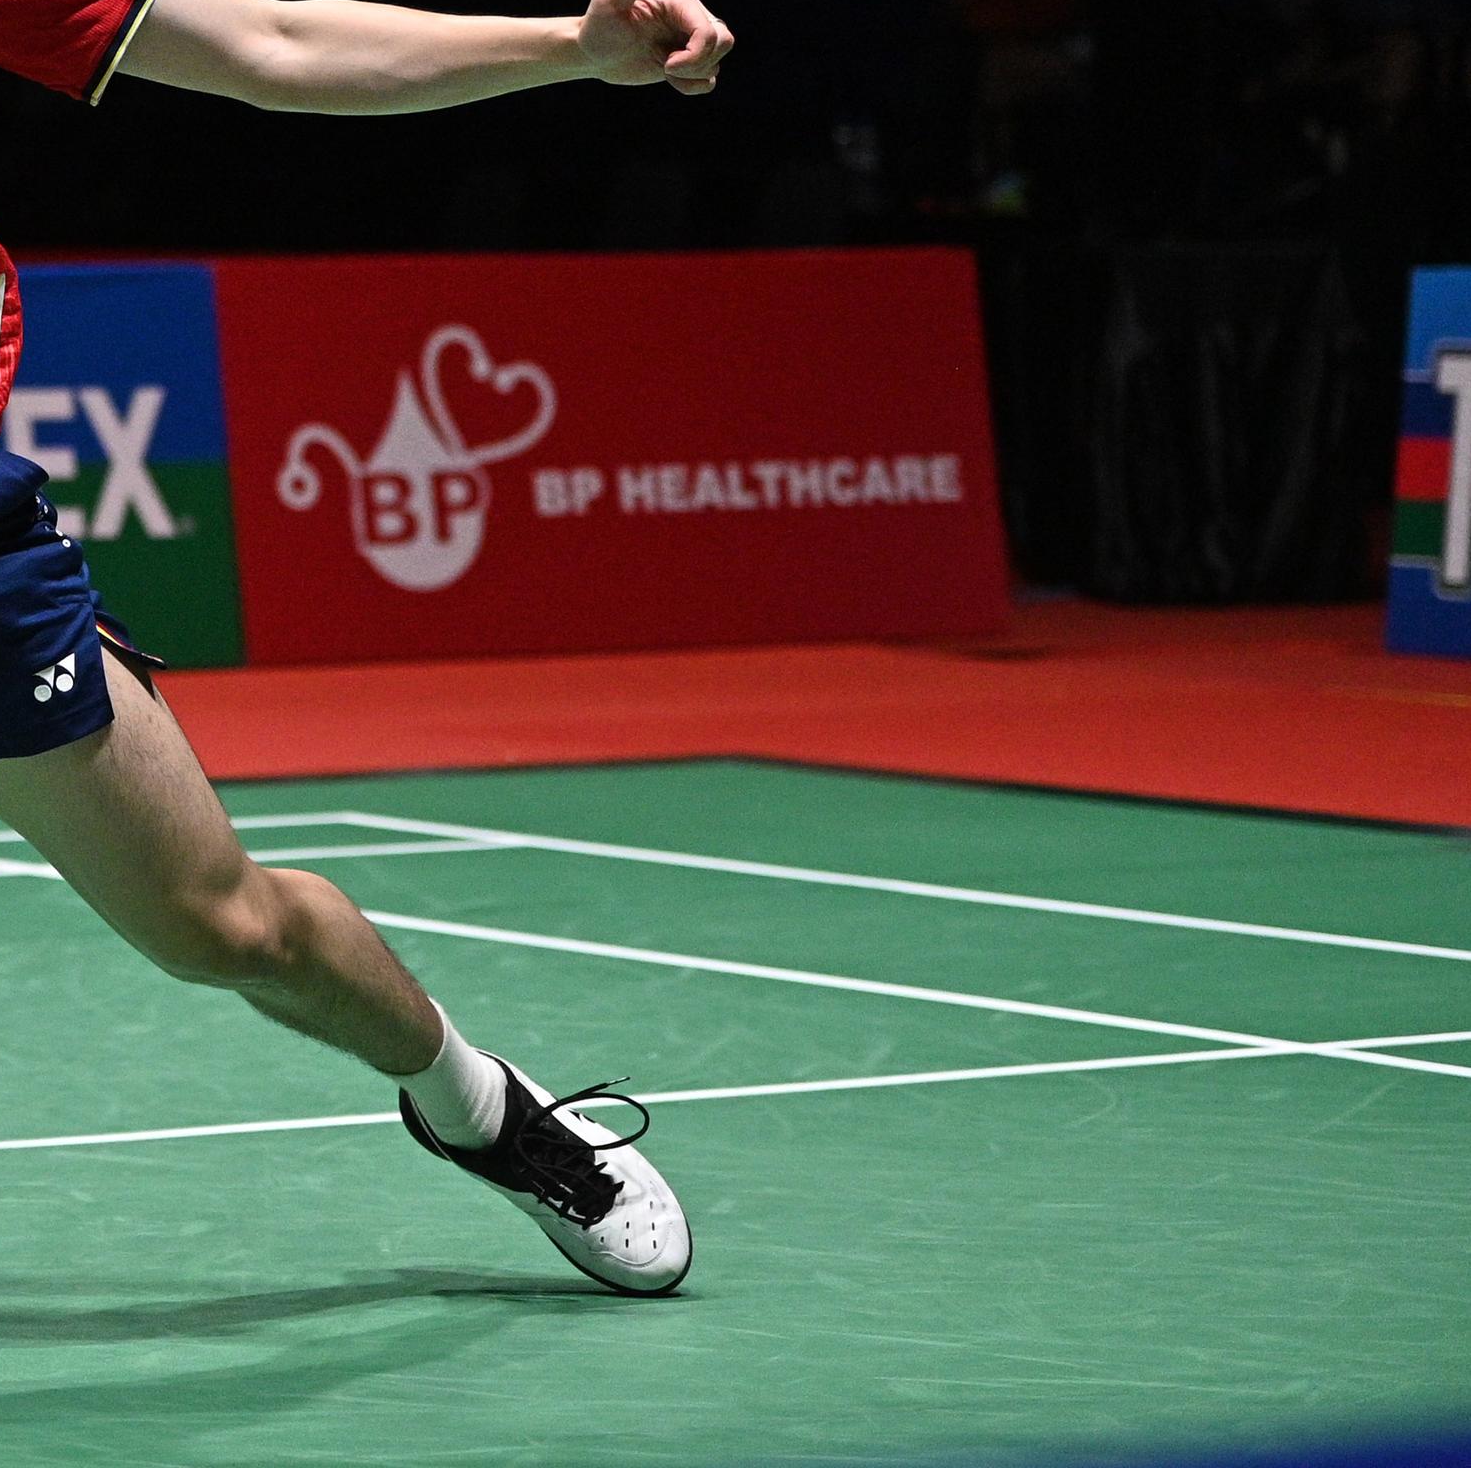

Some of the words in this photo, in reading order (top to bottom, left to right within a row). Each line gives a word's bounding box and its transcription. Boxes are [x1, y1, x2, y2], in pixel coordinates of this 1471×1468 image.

[366, 470, 481, 546] BP
[533, 467, 604, 519] BP
[618, 453, 965, 514] HEALTHCARE
